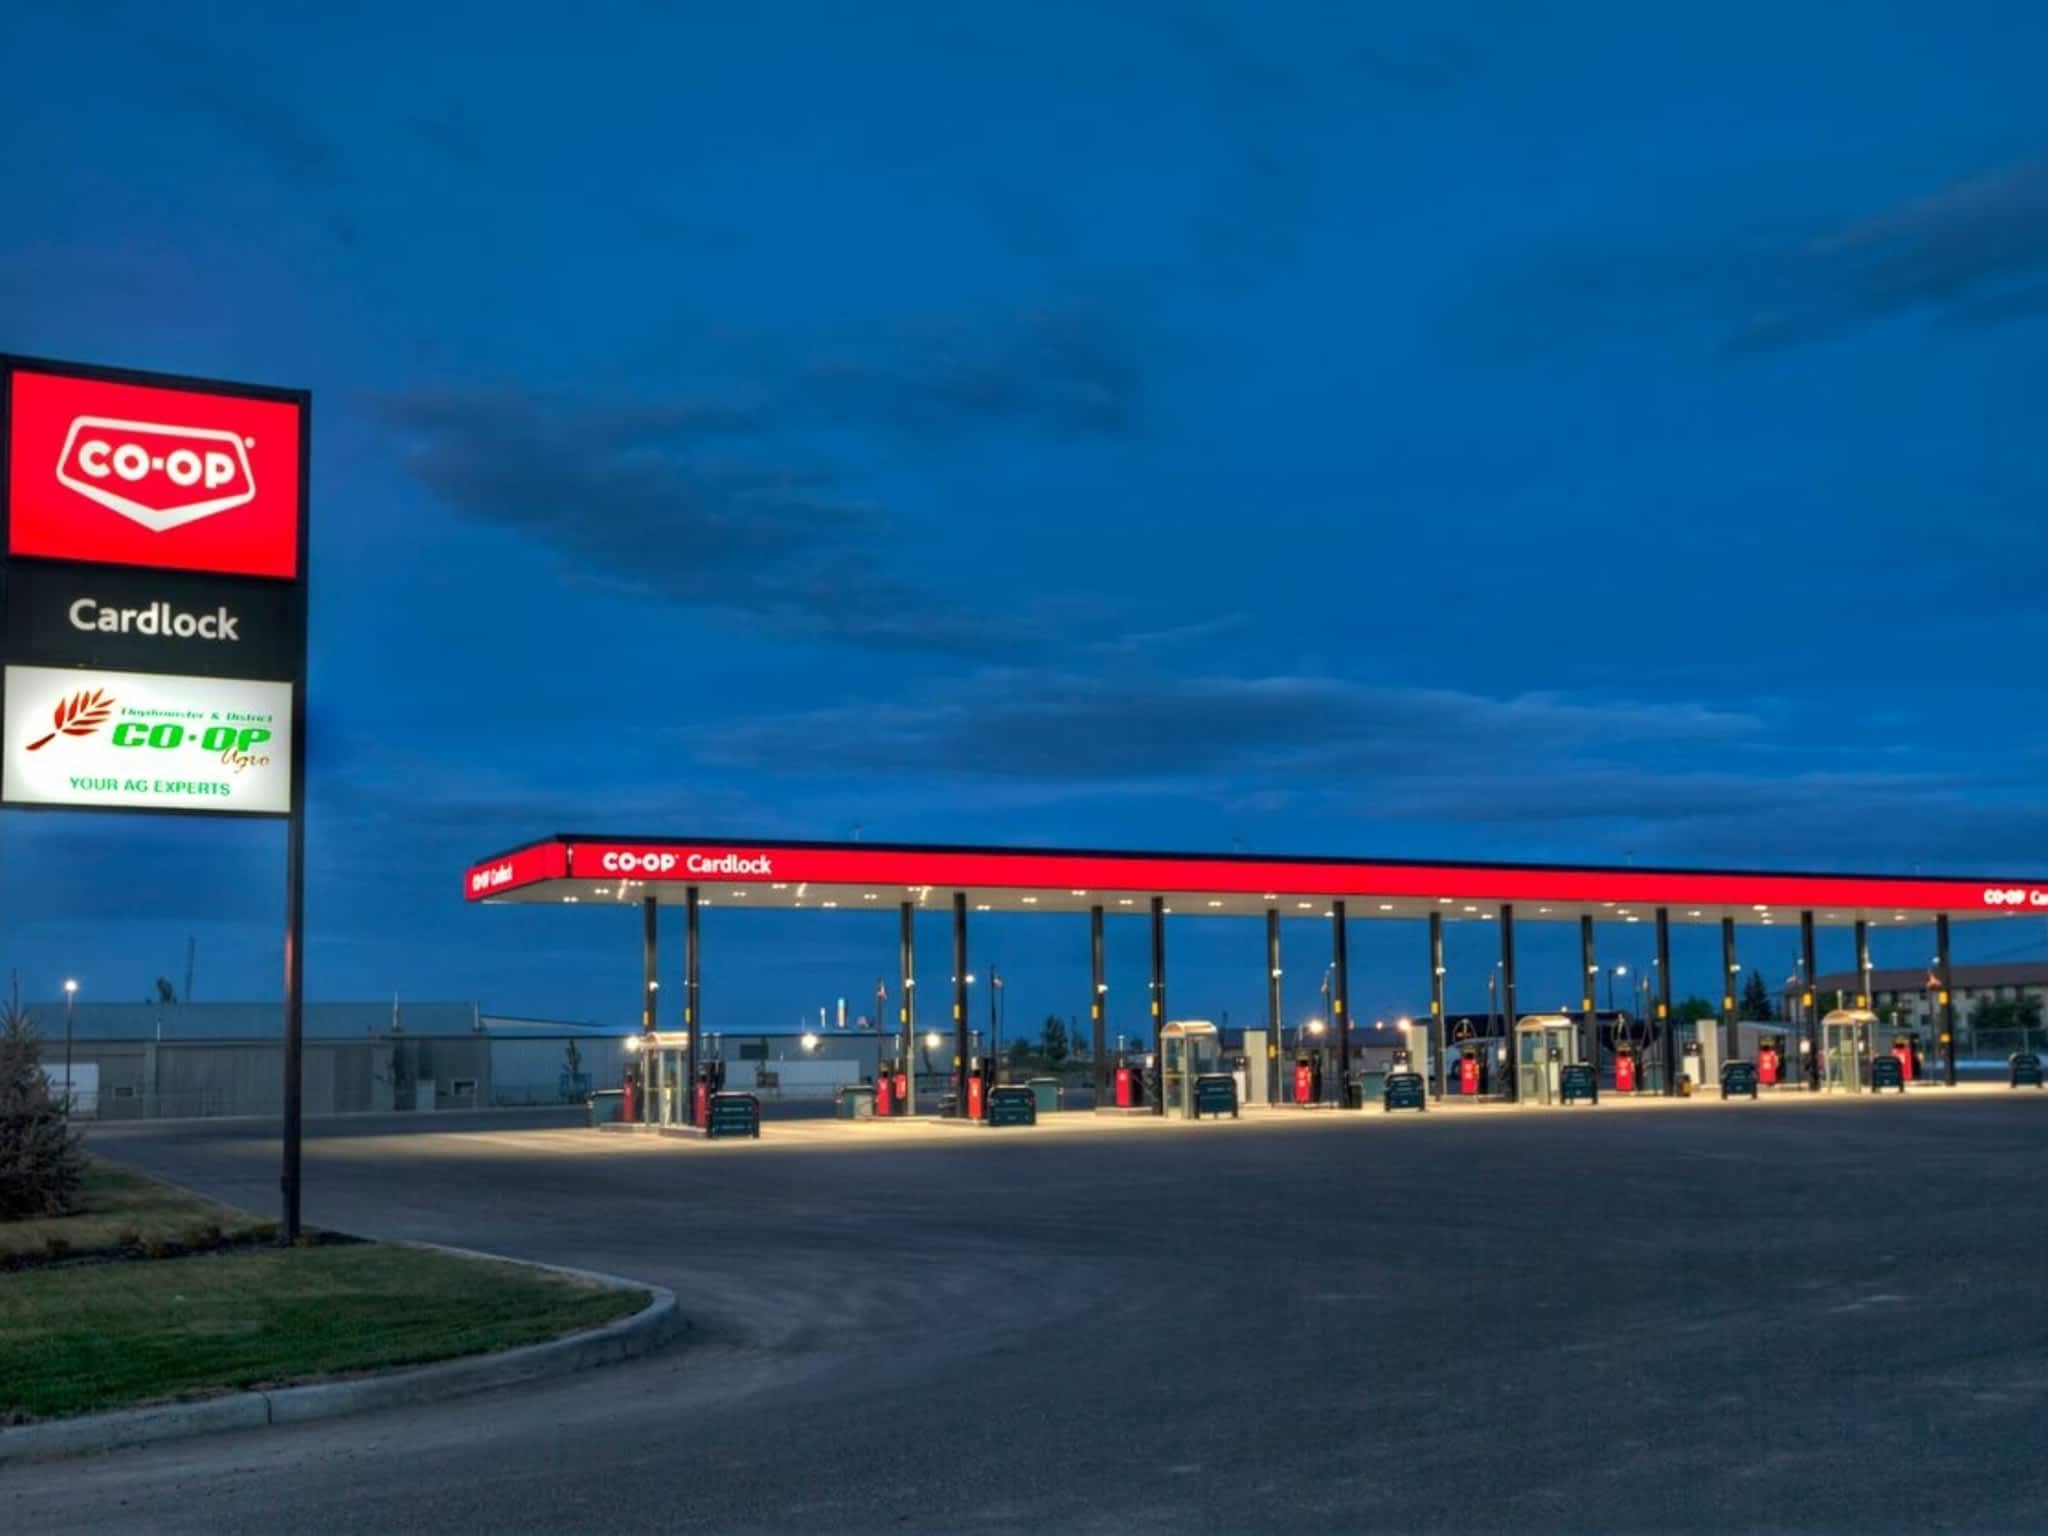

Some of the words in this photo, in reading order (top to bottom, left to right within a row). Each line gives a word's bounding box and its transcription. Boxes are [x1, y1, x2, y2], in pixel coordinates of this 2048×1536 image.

[78, 440, 235, 489] CO-OP
[69, 598, 239, 640] Cardlock
[210, 711, 220, 721] &
[69, 777, 119, 791] YOUR
[123, 779, 149, 793] AG
[153, 780, 231, 796] EXPERTS
[603, 852, 675, 873] CO-OP
[687, 854, 771, 875] Cardlock
